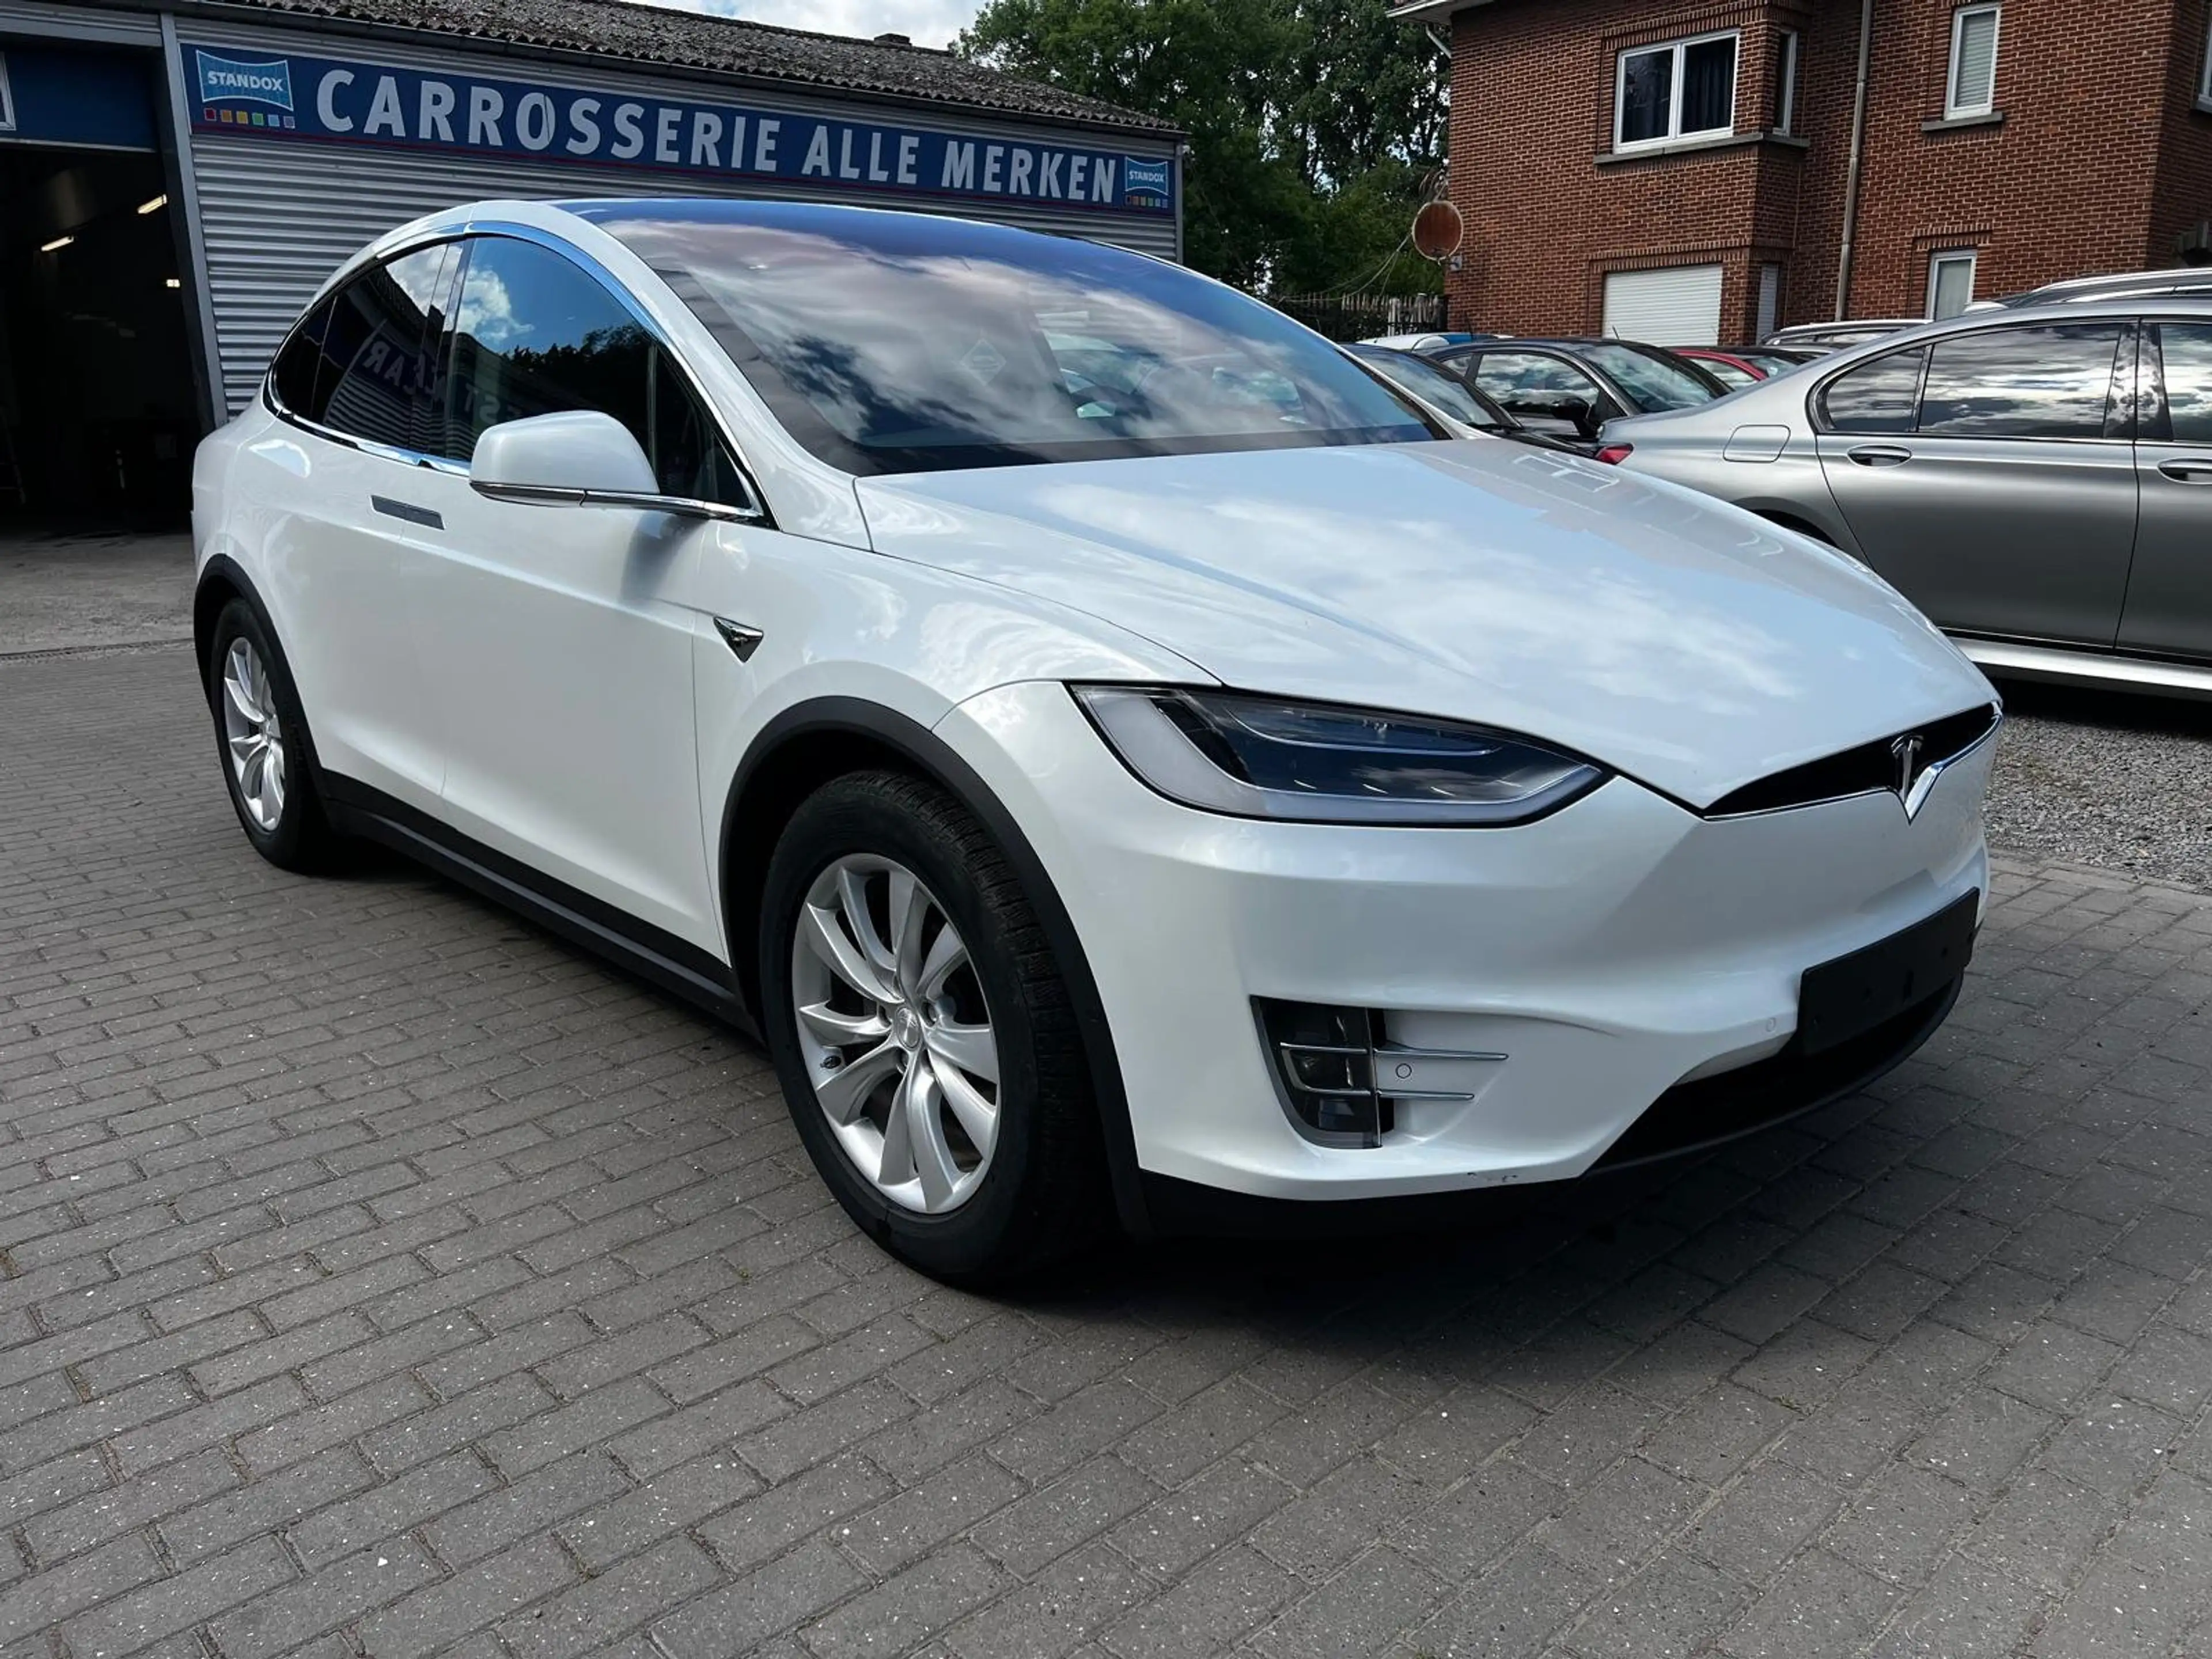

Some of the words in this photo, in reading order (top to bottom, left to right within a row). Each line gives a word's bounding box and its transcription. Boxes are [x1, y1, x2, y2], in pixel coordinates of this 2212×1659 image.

[207, 70, 283, 92] STANDOX
[316, 69, 781, 171] CARROSSERIE
[801, 124, 921, 184] ALLE
[941, 141, 1116, 203] MERKEN
[1129, 171, 1164, 183] STANDOX
